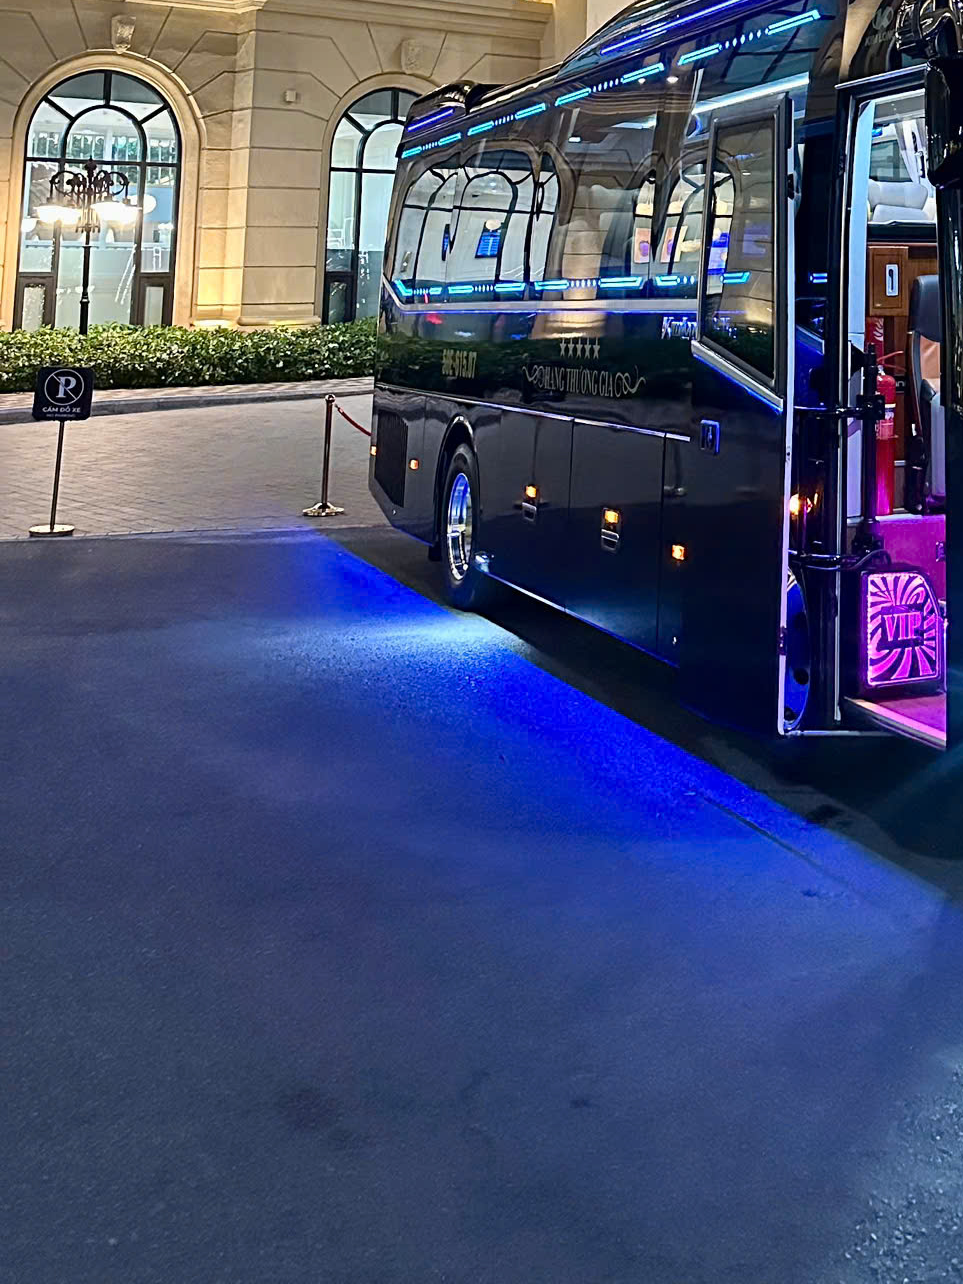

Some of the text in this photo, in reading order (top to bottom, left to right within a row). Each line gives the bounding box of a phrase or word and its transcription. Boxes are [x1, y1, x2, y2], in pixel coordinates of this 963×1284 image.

[55, 376, 77, 398] P
[599, 370, 614, 397] GIA
[883, 612, 922, 642] VIP
